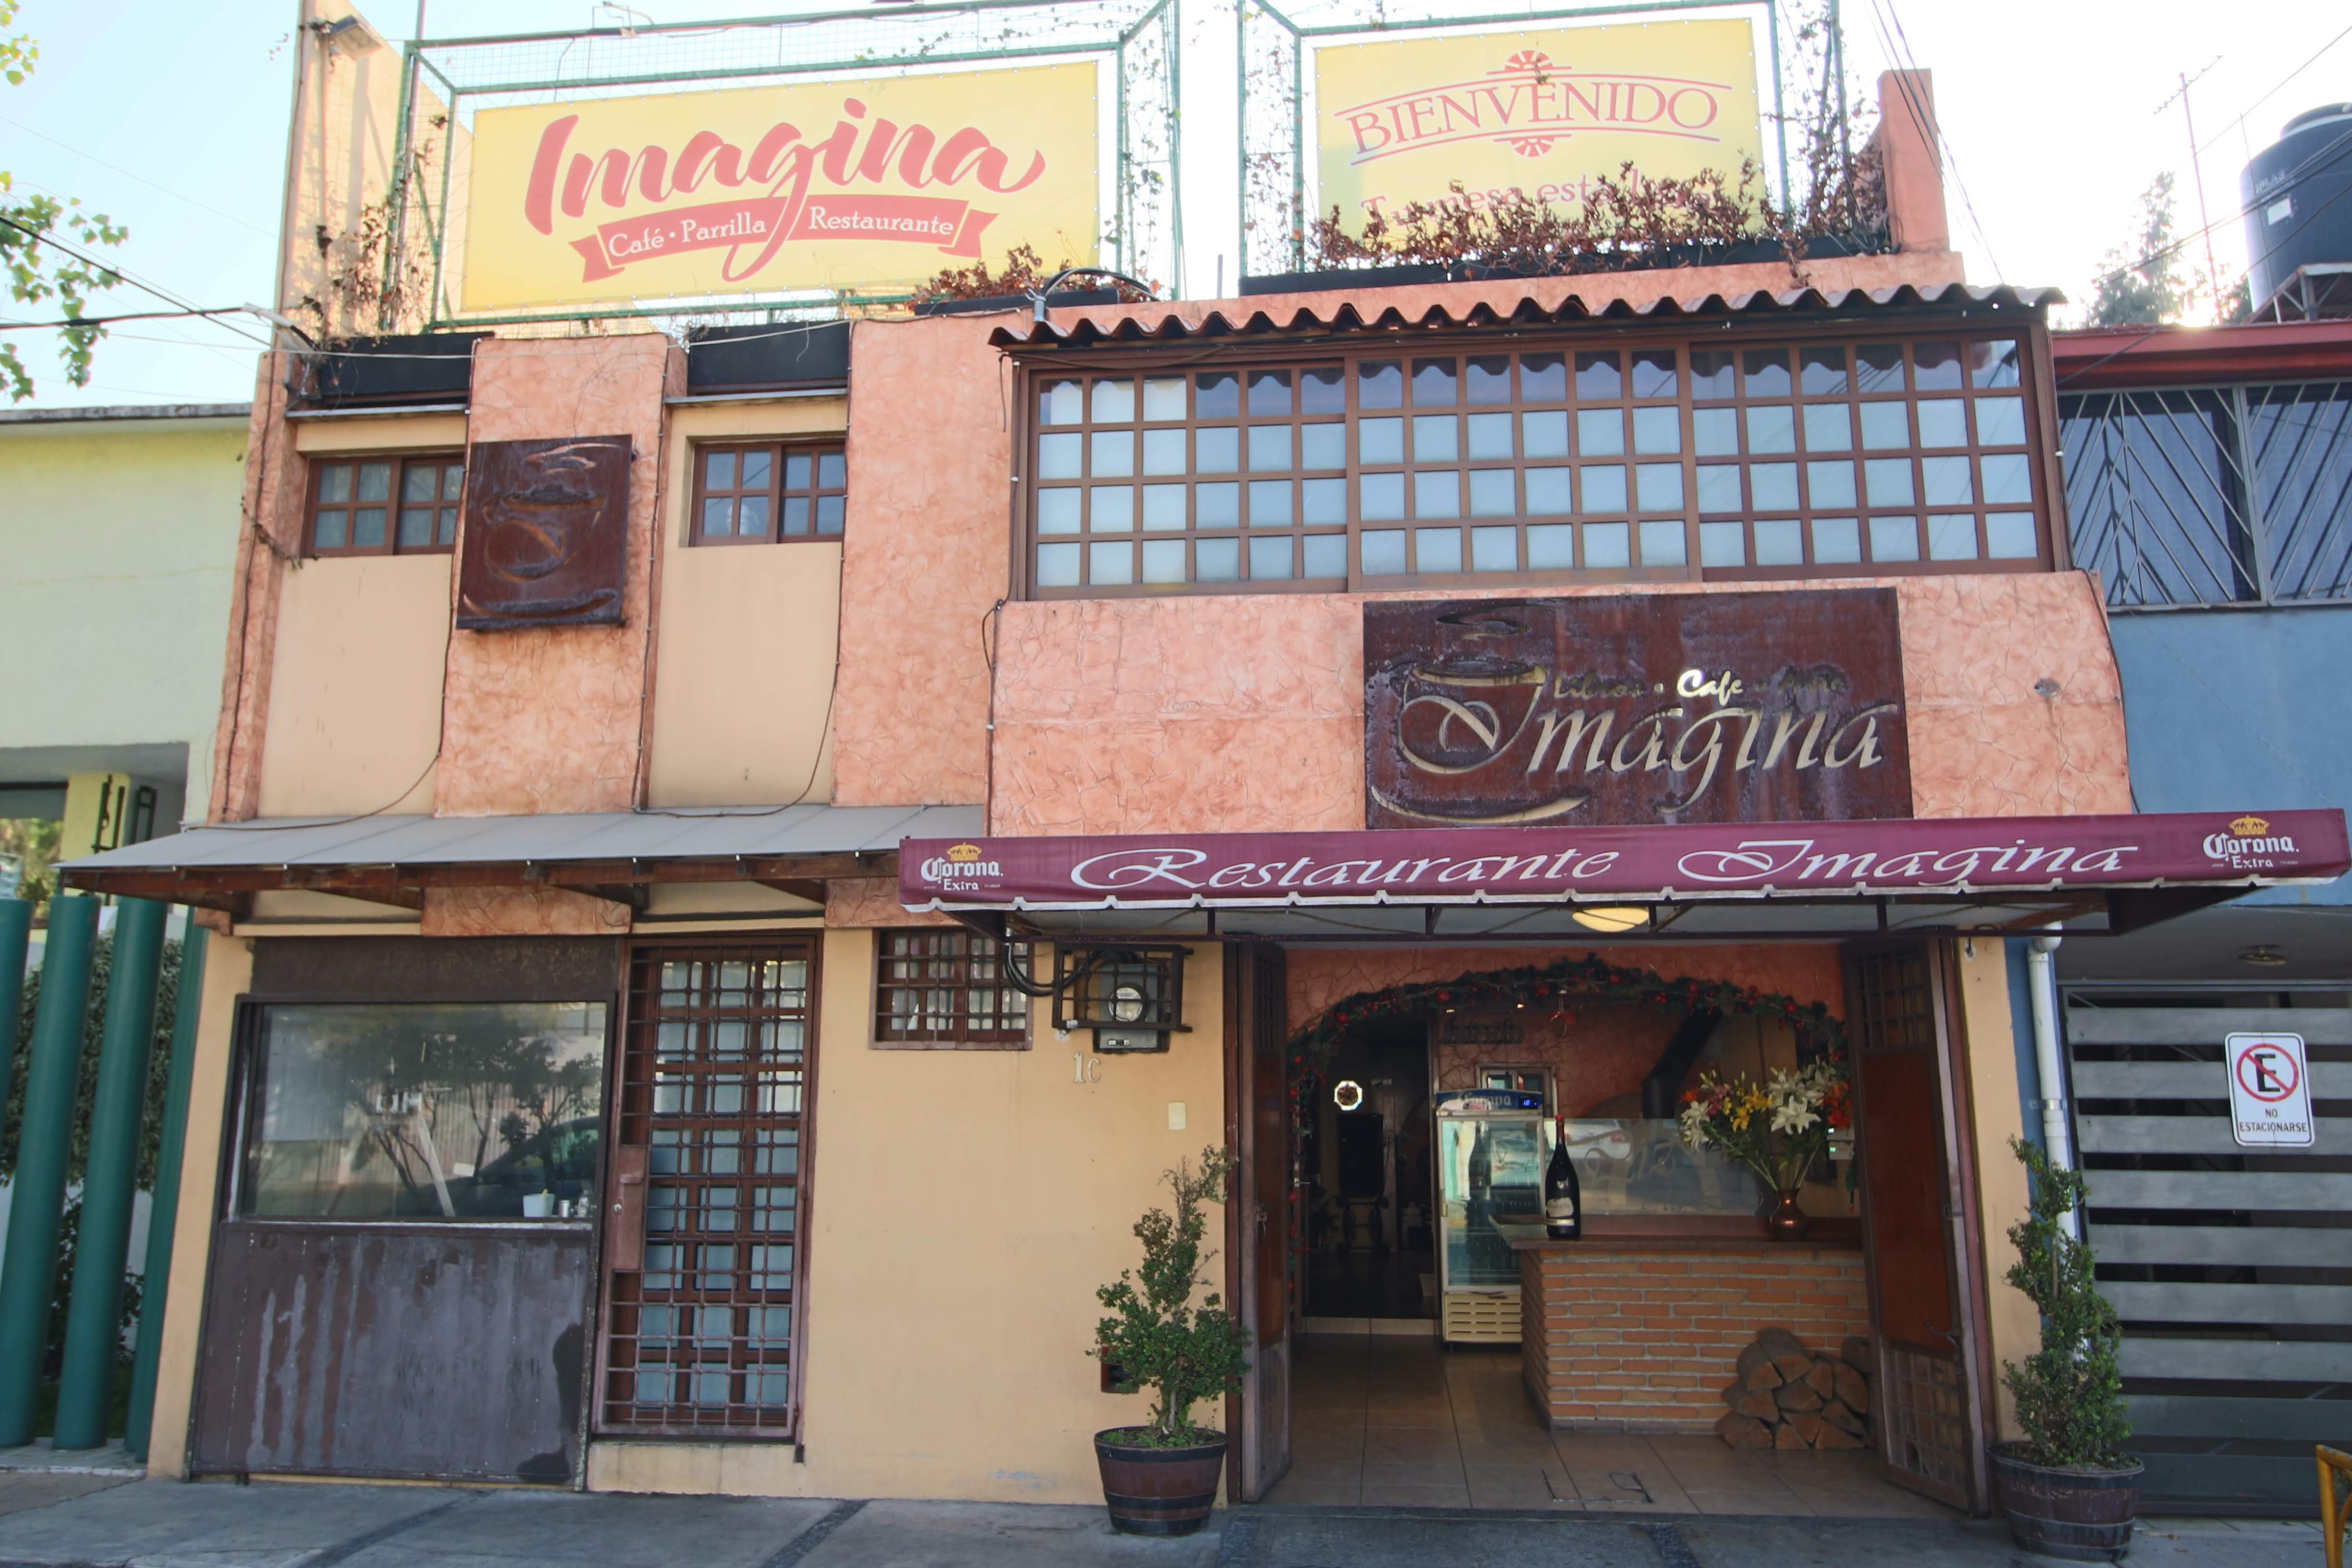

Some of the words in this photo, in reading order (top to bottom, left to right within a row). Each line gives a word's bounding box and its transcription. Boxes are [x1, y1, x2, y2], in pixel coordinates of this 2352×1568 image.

[1346, 81, 1718, 154] BIENVENIDO
[525, 97, 1045, 282] Imagina
[609, 228, 665, 258] Café
[681, 213, 767, 244] Parrilla
[809, 205, 954, 238] Restaurante
[1071, 847, 1620, 889] Restaurante
[1677, 839, 2139, 887] Imagina
[2231, 855, 2274, 869] Extra
[943, 878, 980, 891] Extra
[2239, 1122, 2307, 1132] ESTACIONARSE
[2265, 1109, 2278, 1118] NO
